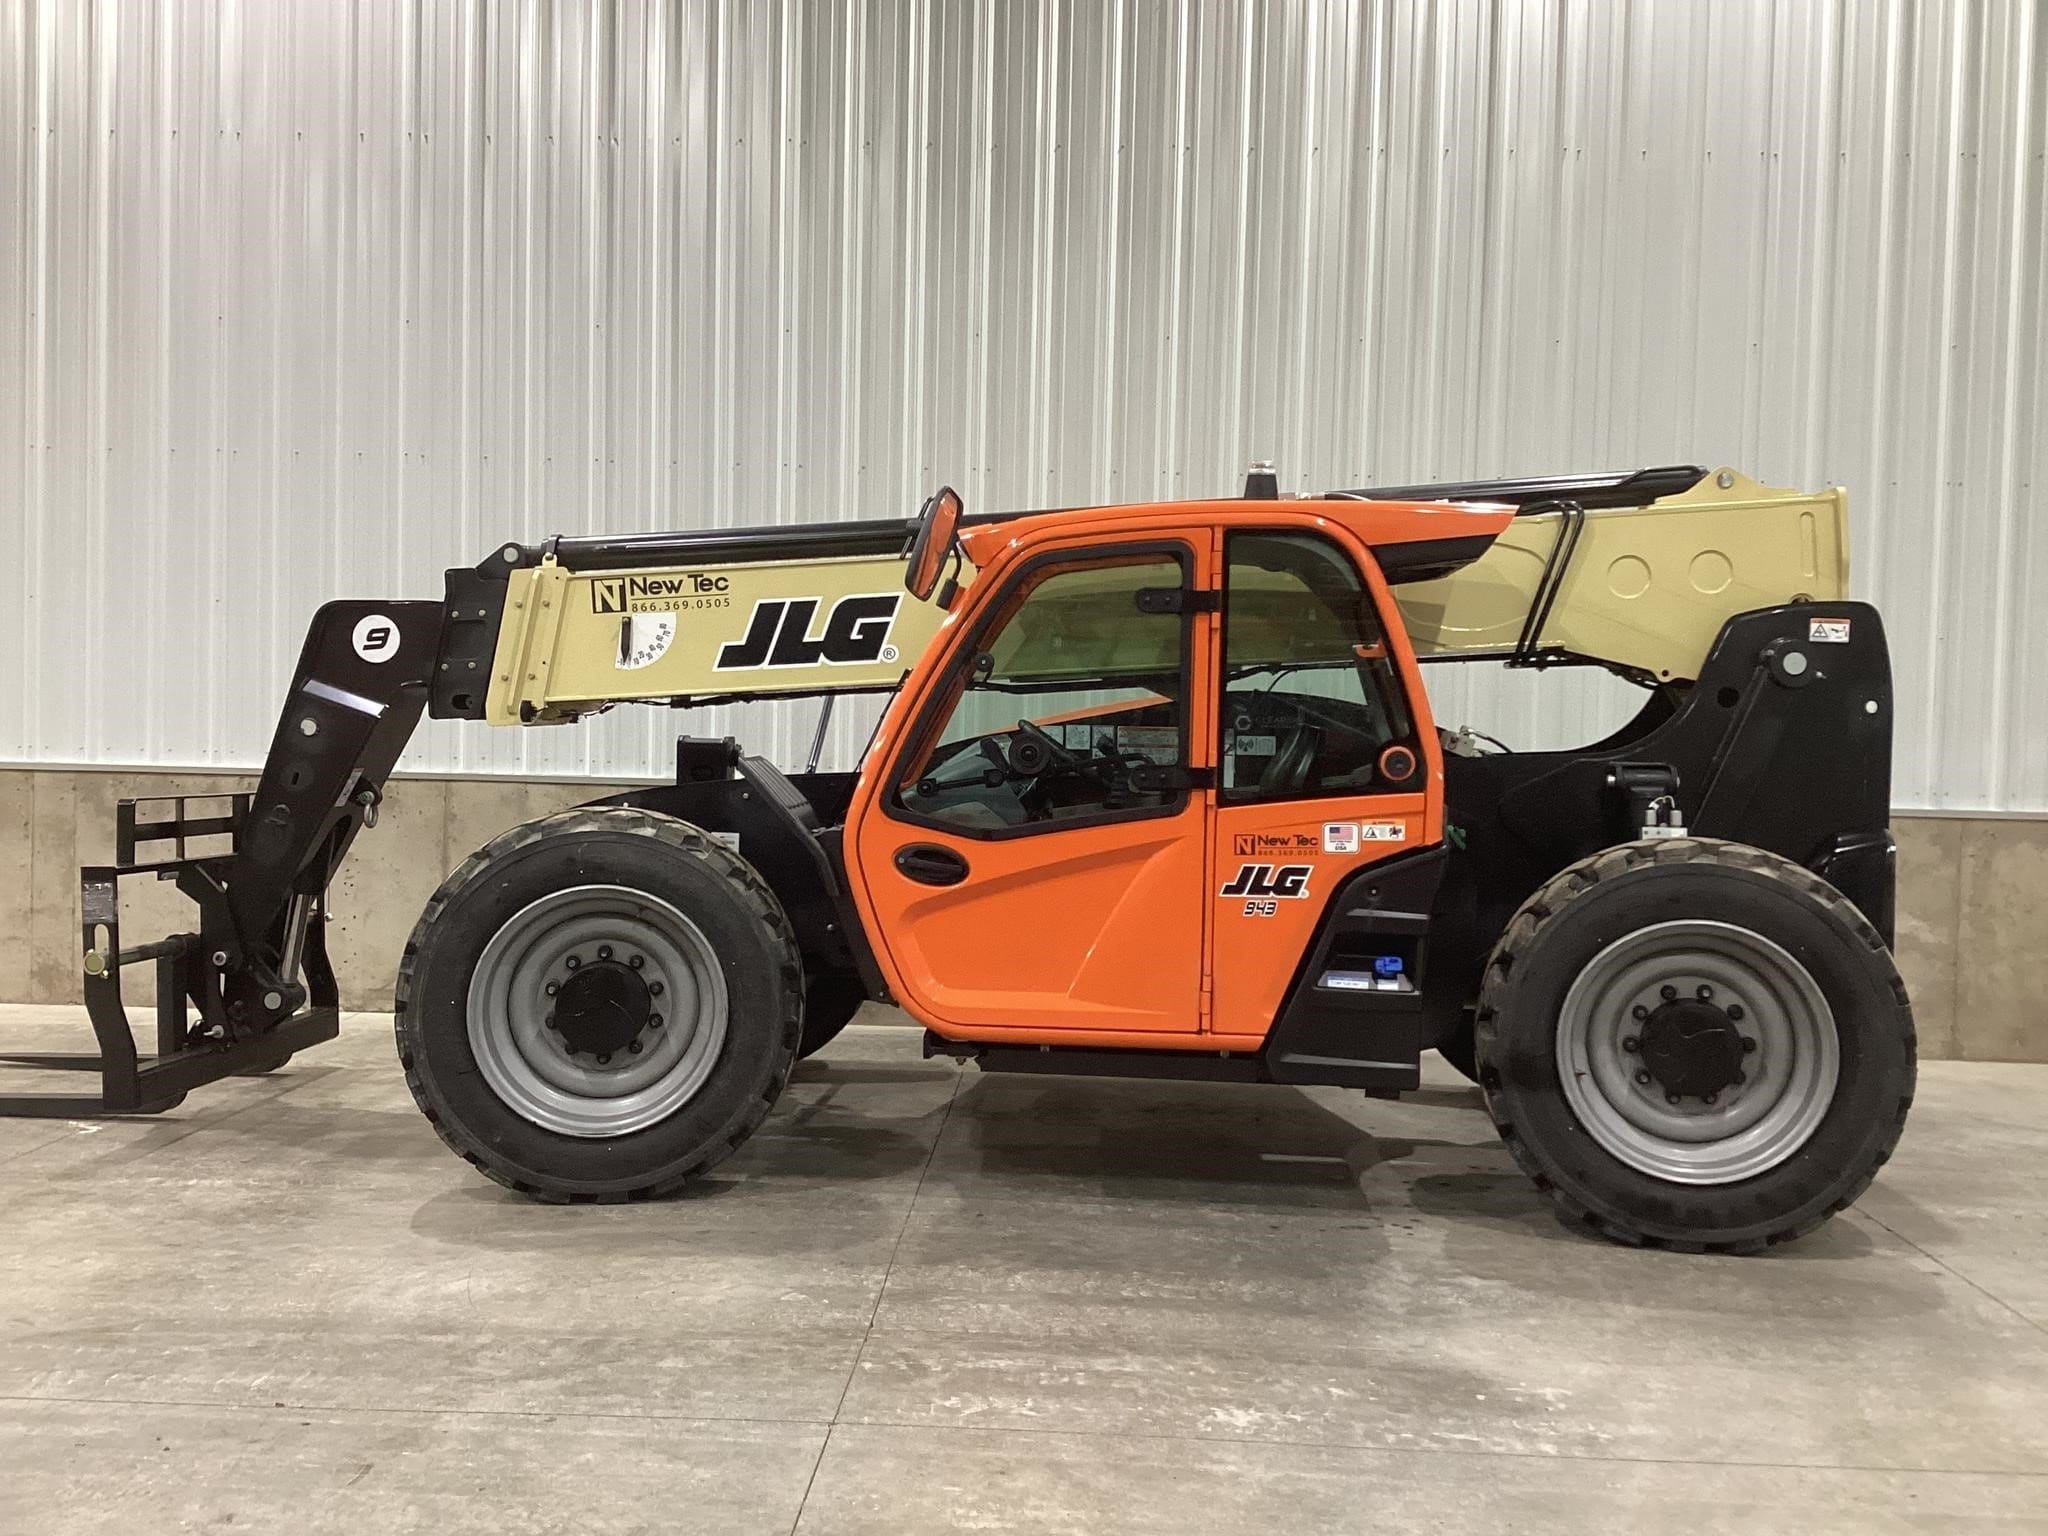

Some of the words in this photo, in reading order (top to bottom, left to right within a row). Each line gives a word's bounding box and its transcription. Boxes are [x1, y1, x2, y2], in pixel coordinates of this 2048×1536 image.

[630, 576, 684, 596] New
[687, 574, 729, 593] Tec
[631, 598, 731, 612] 866.369.0505
[363, 627, 391, 651] 9
[1257, 834, 1291, 846] New
[1292, 834, 1319, 846] Tec
[1220, 865, 1313, 897] JLG
[1244, 901, 1277, 915] 943
